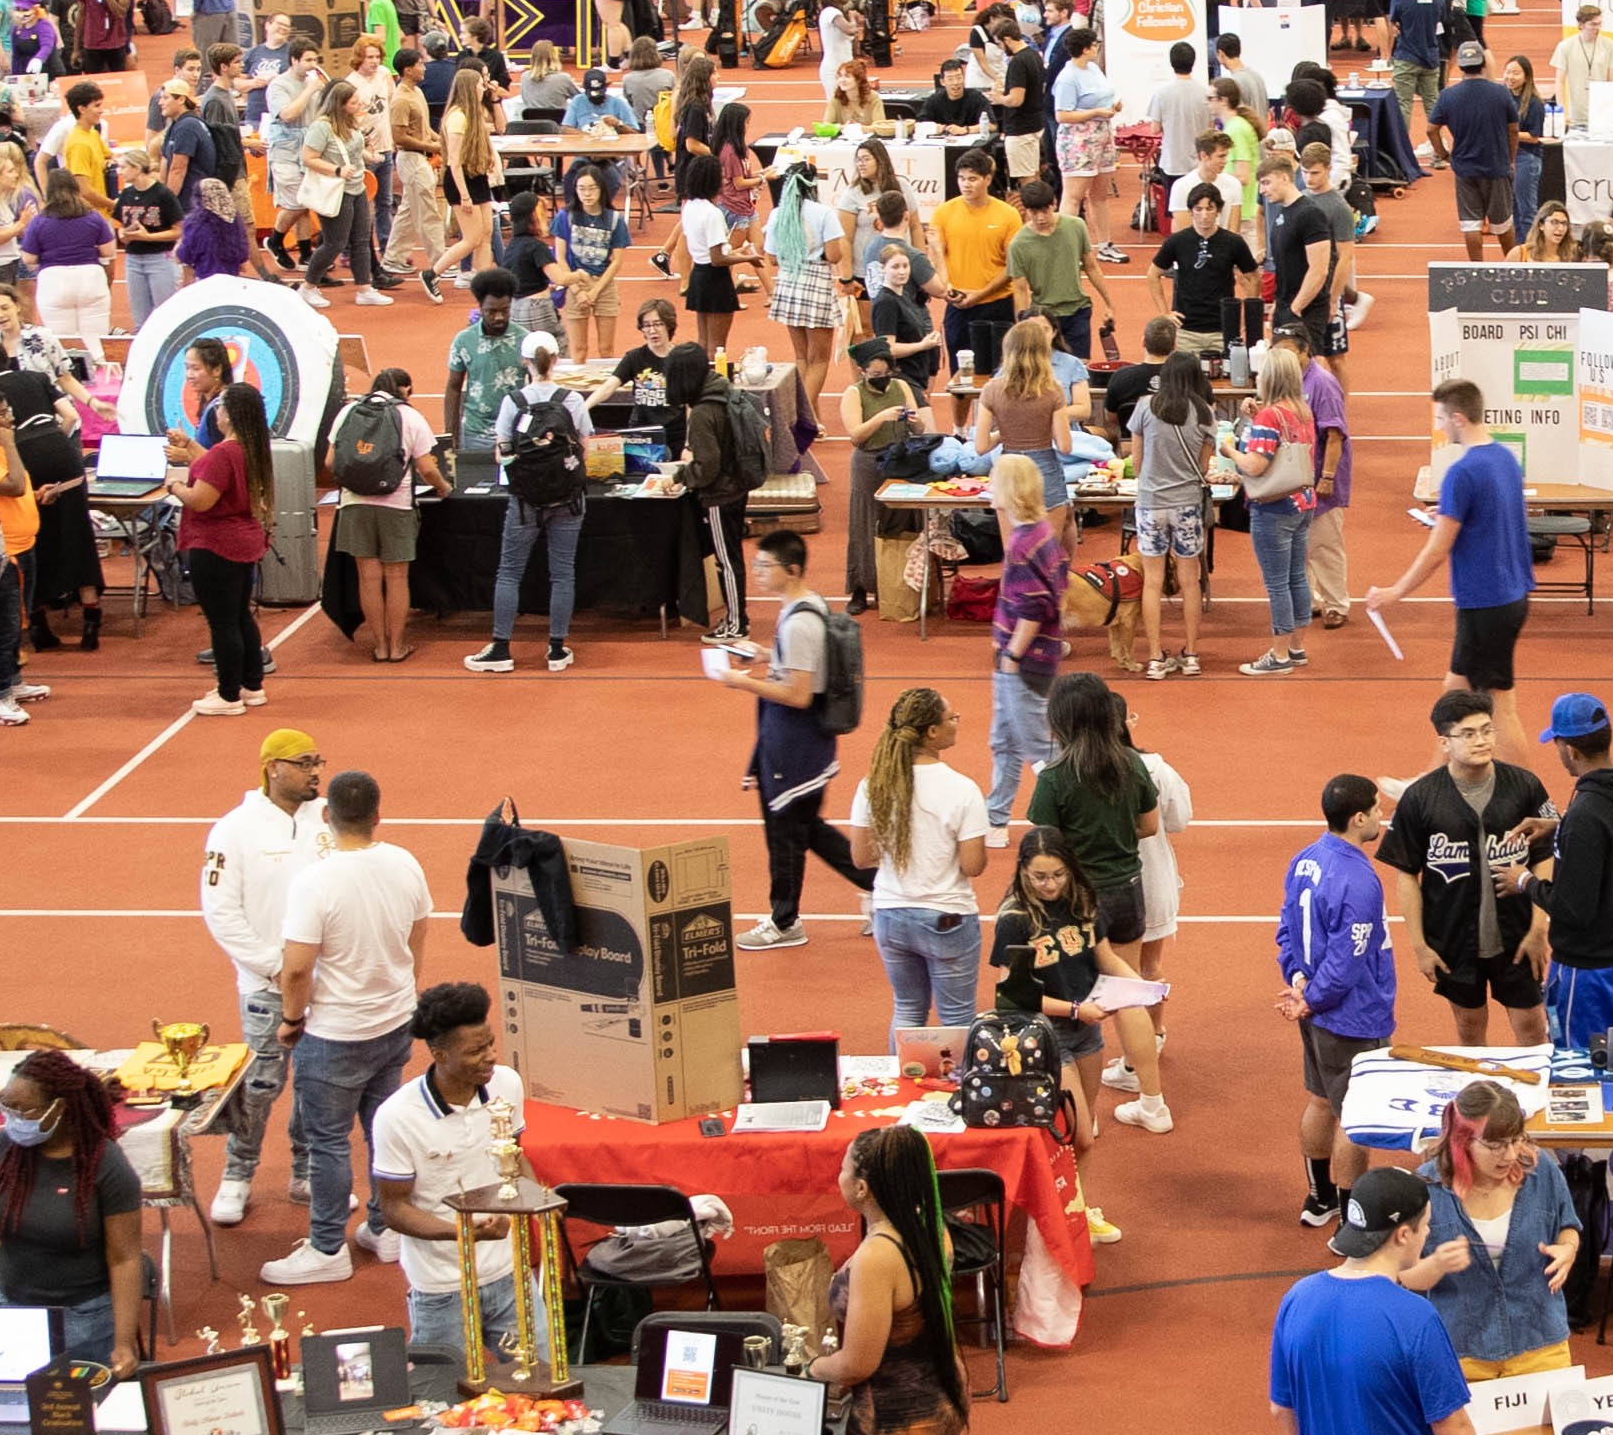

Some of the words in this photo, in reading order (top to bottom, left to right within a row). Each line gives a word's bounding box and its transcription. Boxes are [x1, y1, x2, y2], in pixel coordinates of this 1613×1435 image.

[1490, 289, 1548, 305] CLUB
[1463, 325, 1504, 340] BOARD
[1519, 325, 1539, 340] PSI
[1546, 325, 1567, 340] CHI
[1590, 369, 1605, 384] US
[1484, 409, 1523, 425] ETING
[1531, 409, 1560, 425] INFO
[683, 924, 724, 942] ELMER'S
[524, 932, 560, 950] Tri-Fo
[599, 946, 632, 964] Board
[682, 939, 728, 960] Tri-Fold
[1493, 1391, 1528, 1411] FIJI
